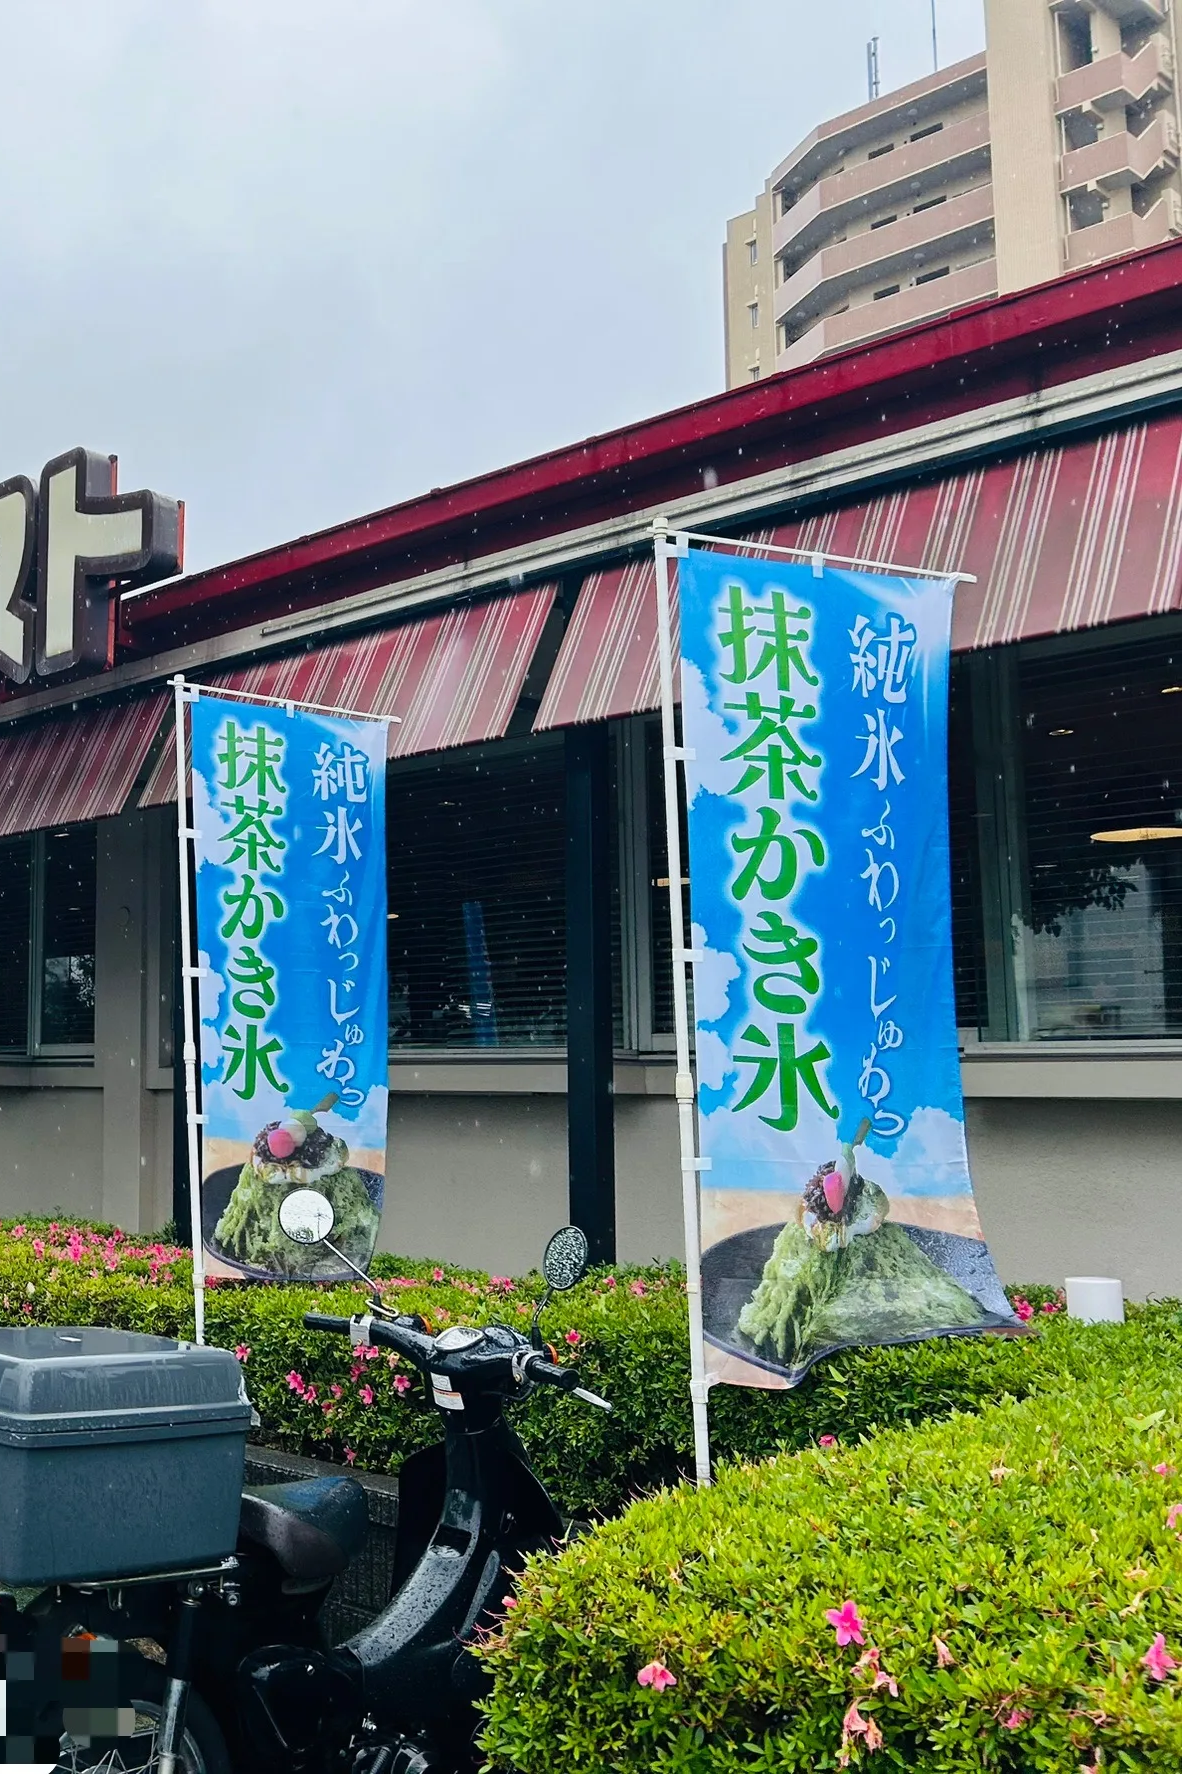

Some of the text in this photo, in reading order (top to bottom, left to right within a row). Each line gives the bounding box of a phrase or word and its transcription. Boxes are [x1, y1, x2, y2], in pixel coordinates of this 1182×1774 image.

[217, 721, 289, 1100] 抹茶かき氷
[719, 585, 840, 1131] 抹茶かき氷
